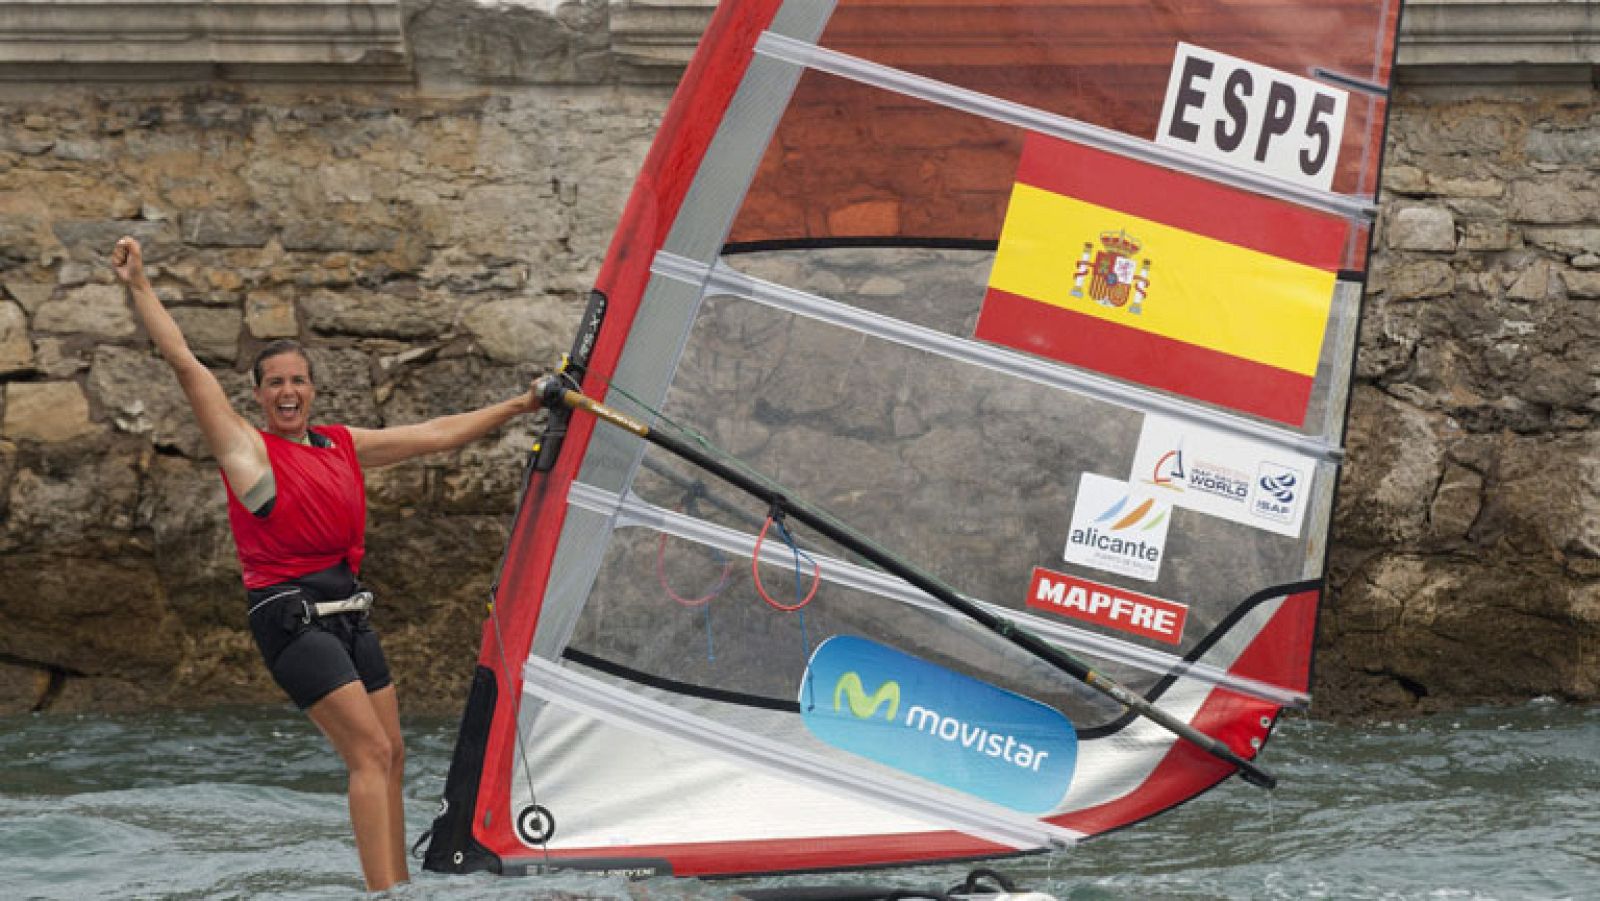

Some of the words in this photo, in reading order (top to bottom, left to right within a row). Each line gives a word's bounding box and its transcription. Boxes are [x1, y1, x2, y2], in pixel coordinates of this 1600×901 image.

[1190, 474, 1248, 497] WORLD
[1070, 527, 1159, 562] alicante
[1036, 577, 1178, 635] MAPFRE
[905, 704, 1049, 772] movistar
